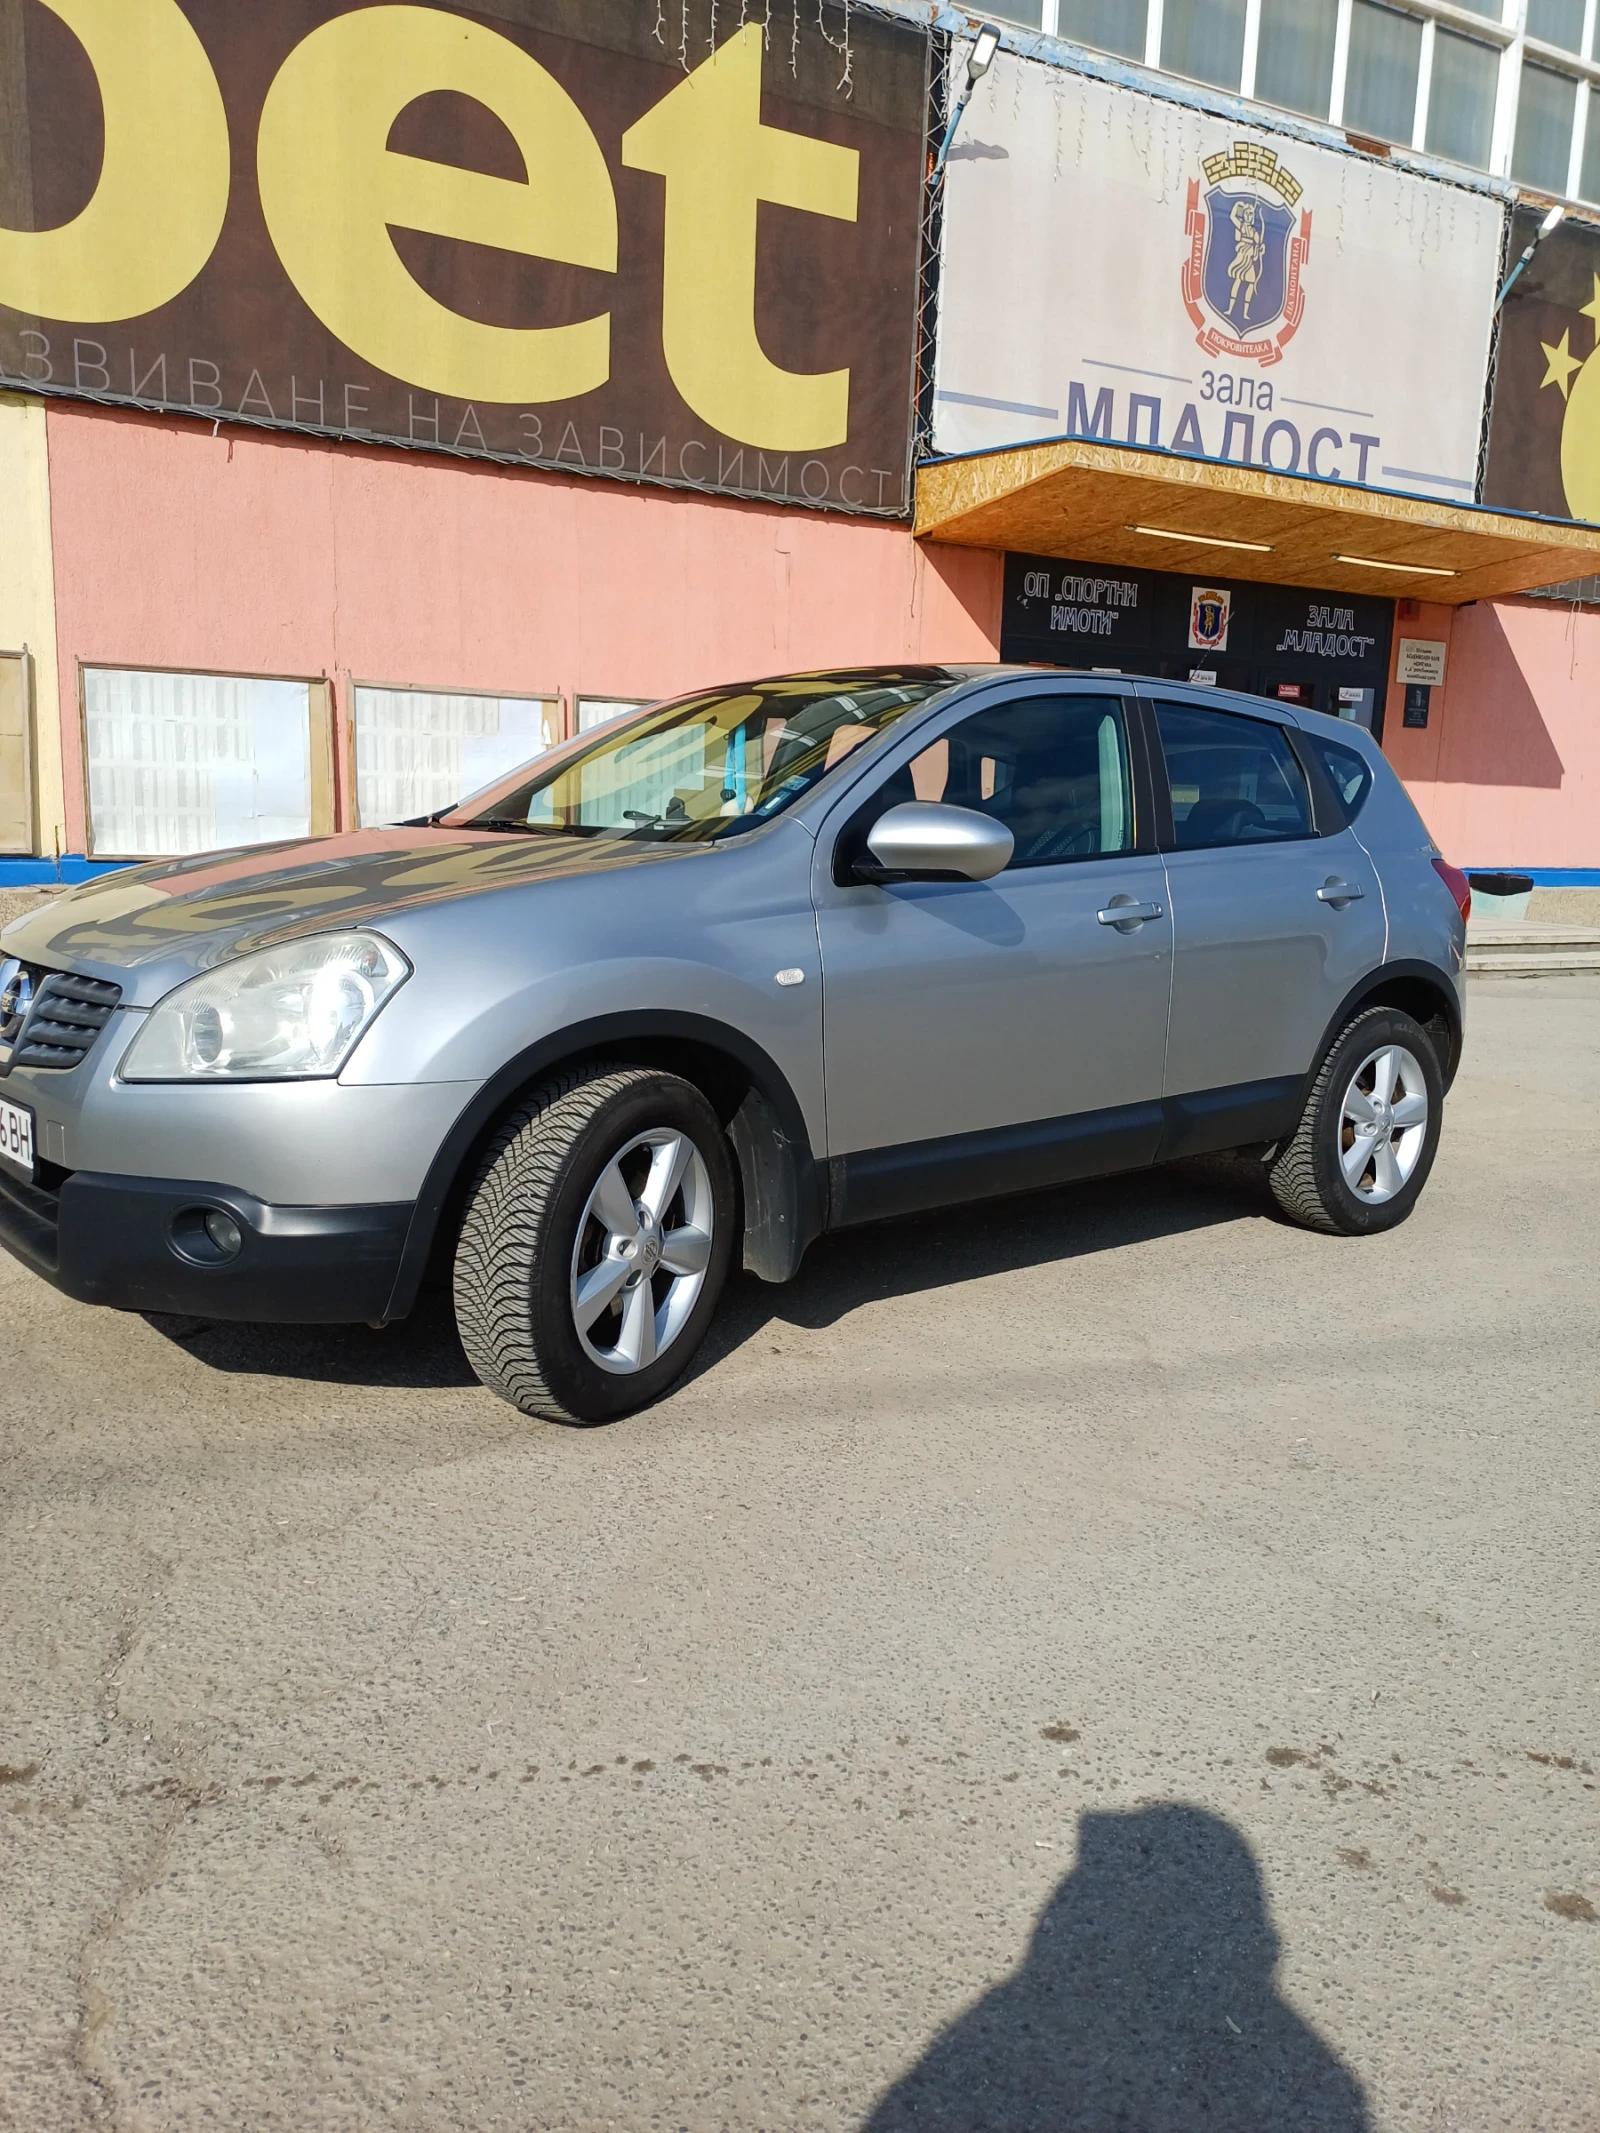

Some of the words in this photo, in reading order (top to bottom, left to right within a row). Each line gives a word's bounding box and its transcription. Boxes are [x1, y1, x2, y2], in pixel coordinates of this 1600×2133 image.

[1192, 229, 1203, 277] ДИАНА
[1289, 241, 1300, 296] МОНТАНА
[1210, 331, 1270, 354] ПОКРОВИТЕЛКА
[1200, 369, 1274, 412] зала
[0, 330, 370, 430] ЗВИВАНЕ
[408, 394, 488, 451] НА
[518, 413, 904, 507] ЗАВИСИМОСТ
[1024, 571, 1050, 598] ОП
[1306, 605, 1354, 631] ЗАЛА
